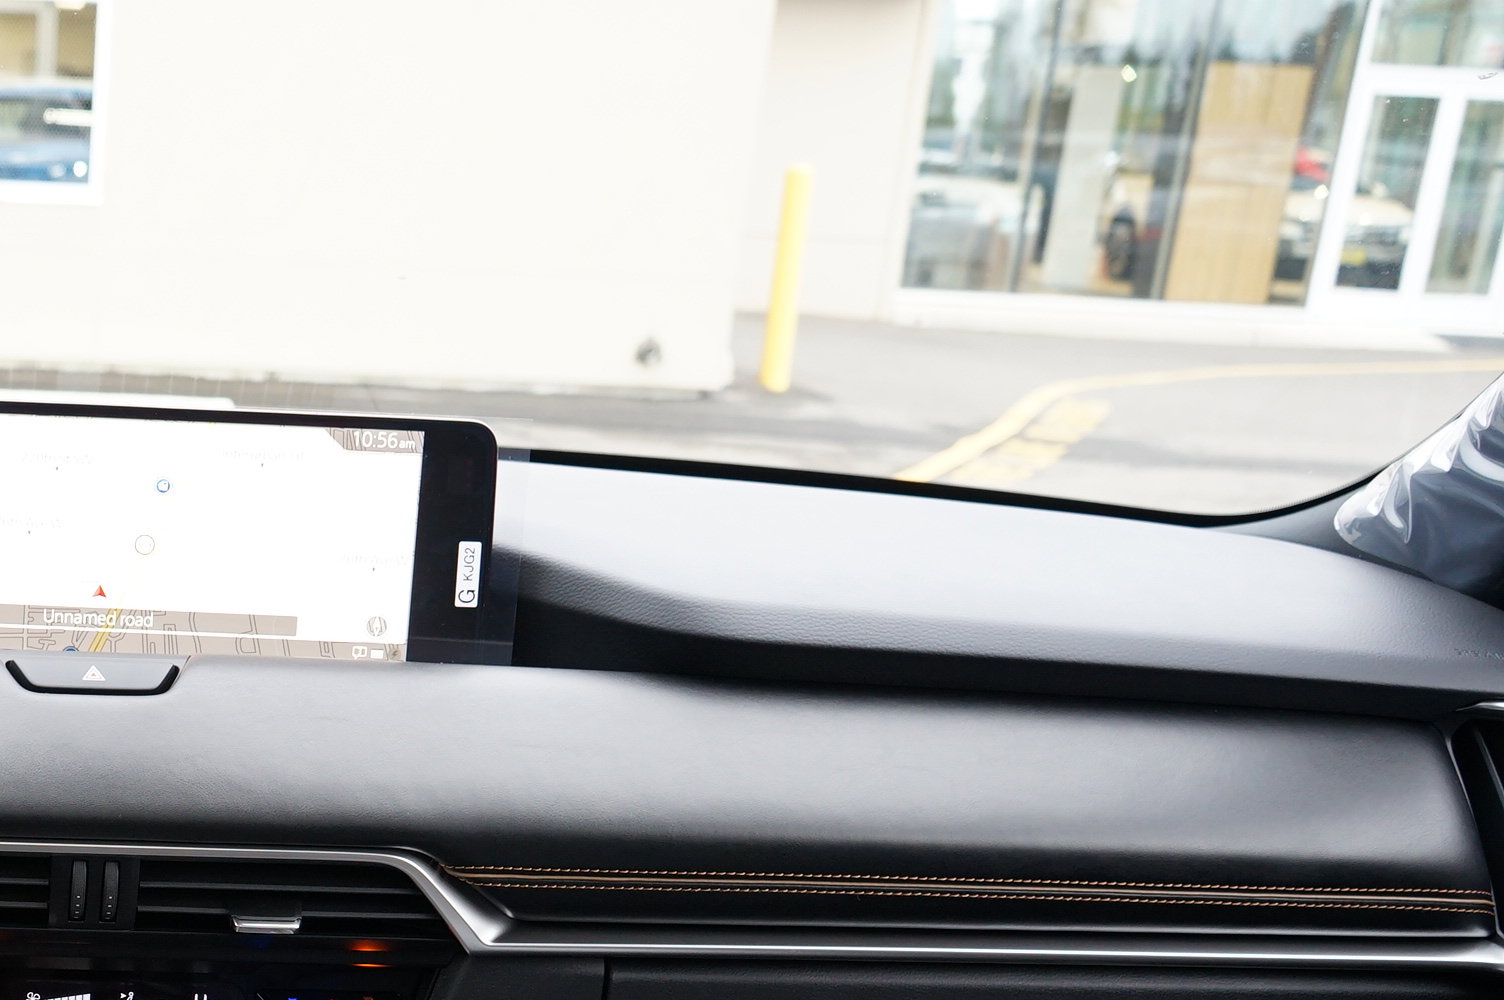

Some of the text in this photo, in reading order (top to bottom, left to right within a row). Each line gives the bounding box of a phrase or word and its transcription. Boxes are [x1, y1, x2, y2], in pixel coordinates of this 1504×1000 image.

[354, 431, 415, 449] 10:56 am
[458, 547, 475, 603] G KJG2
[43, 608, 154, 627] Unnamed road
